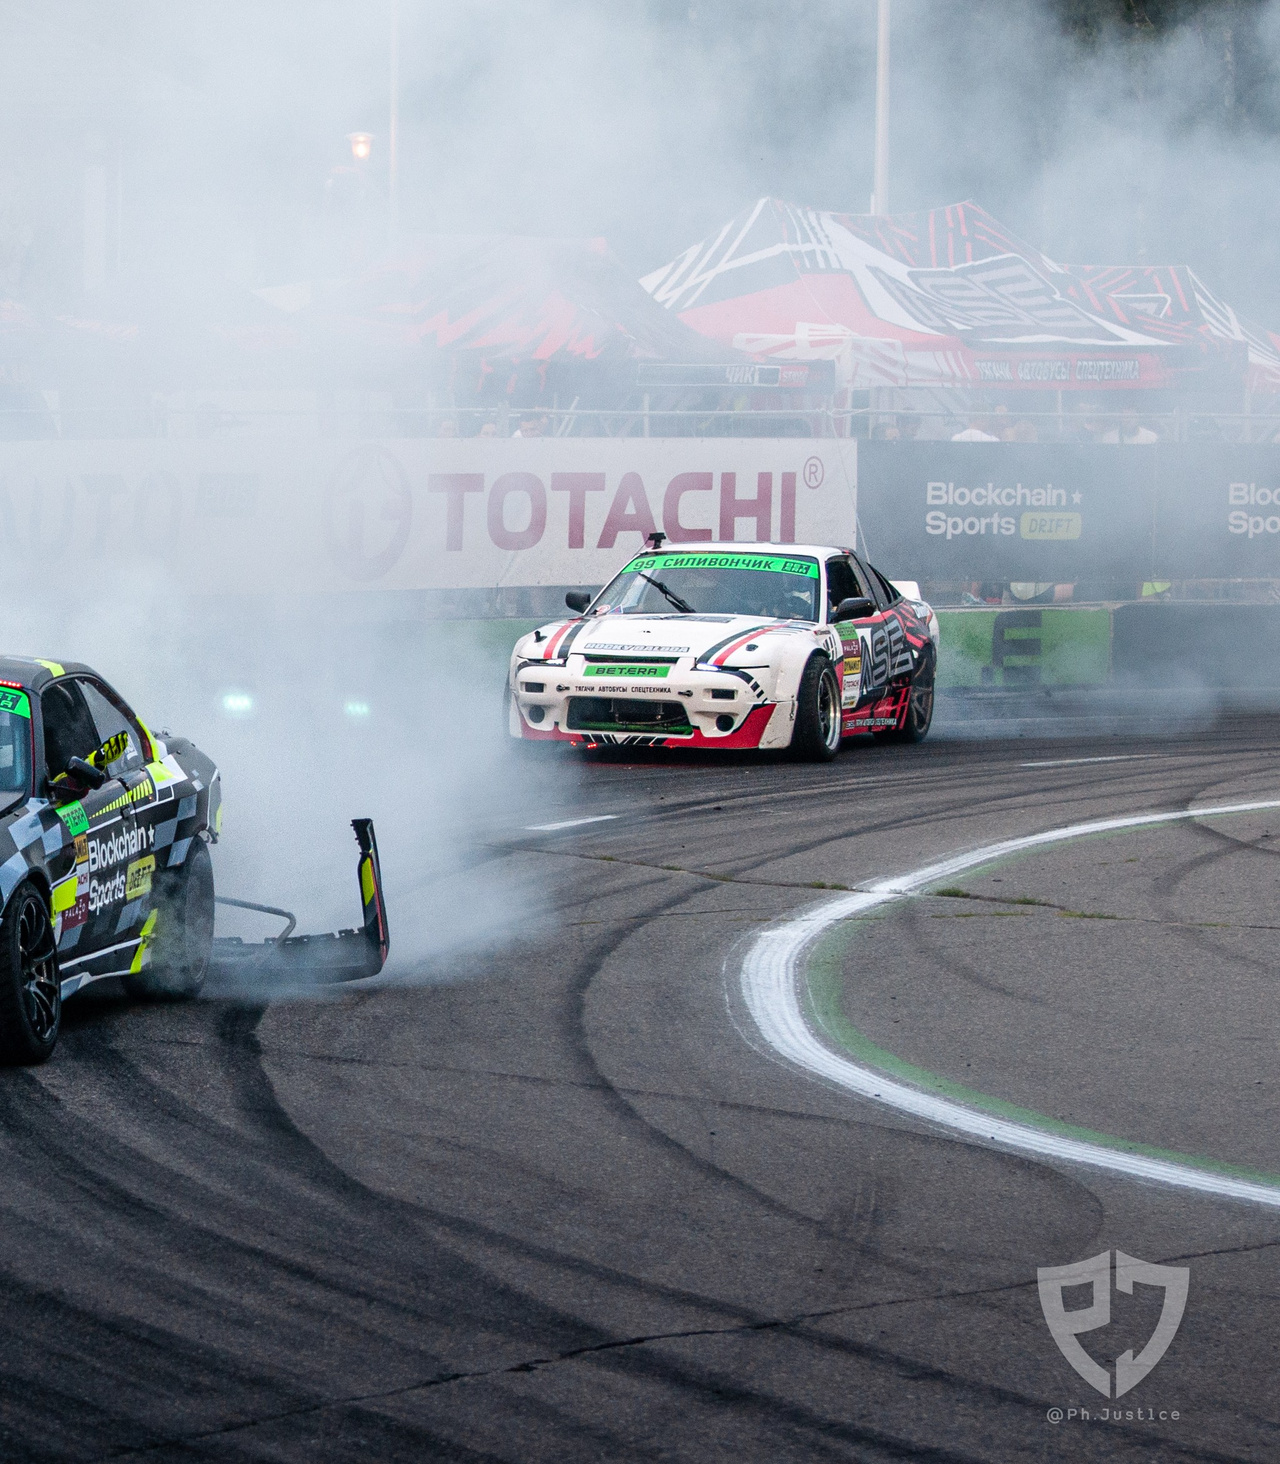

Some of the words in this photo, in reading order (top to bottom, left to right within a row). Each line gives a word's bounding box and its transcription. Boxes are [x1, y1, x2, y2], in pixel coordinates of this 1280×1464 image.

[1076, 360, 1140, 382] СПЕЦТЕХНИКА
[926, 481, 1067, 506] Blockchain
[925, 510, 1017, 540] Sports
[1028, 518, 1073, 534] DRIFT
[633, 559, 656, 570] 99
[663, 557, 774, 570] СИЛИВОНЧИК
[88, 820, 147, 873] Blockchain
[88, 870, 126, 915] Sports
